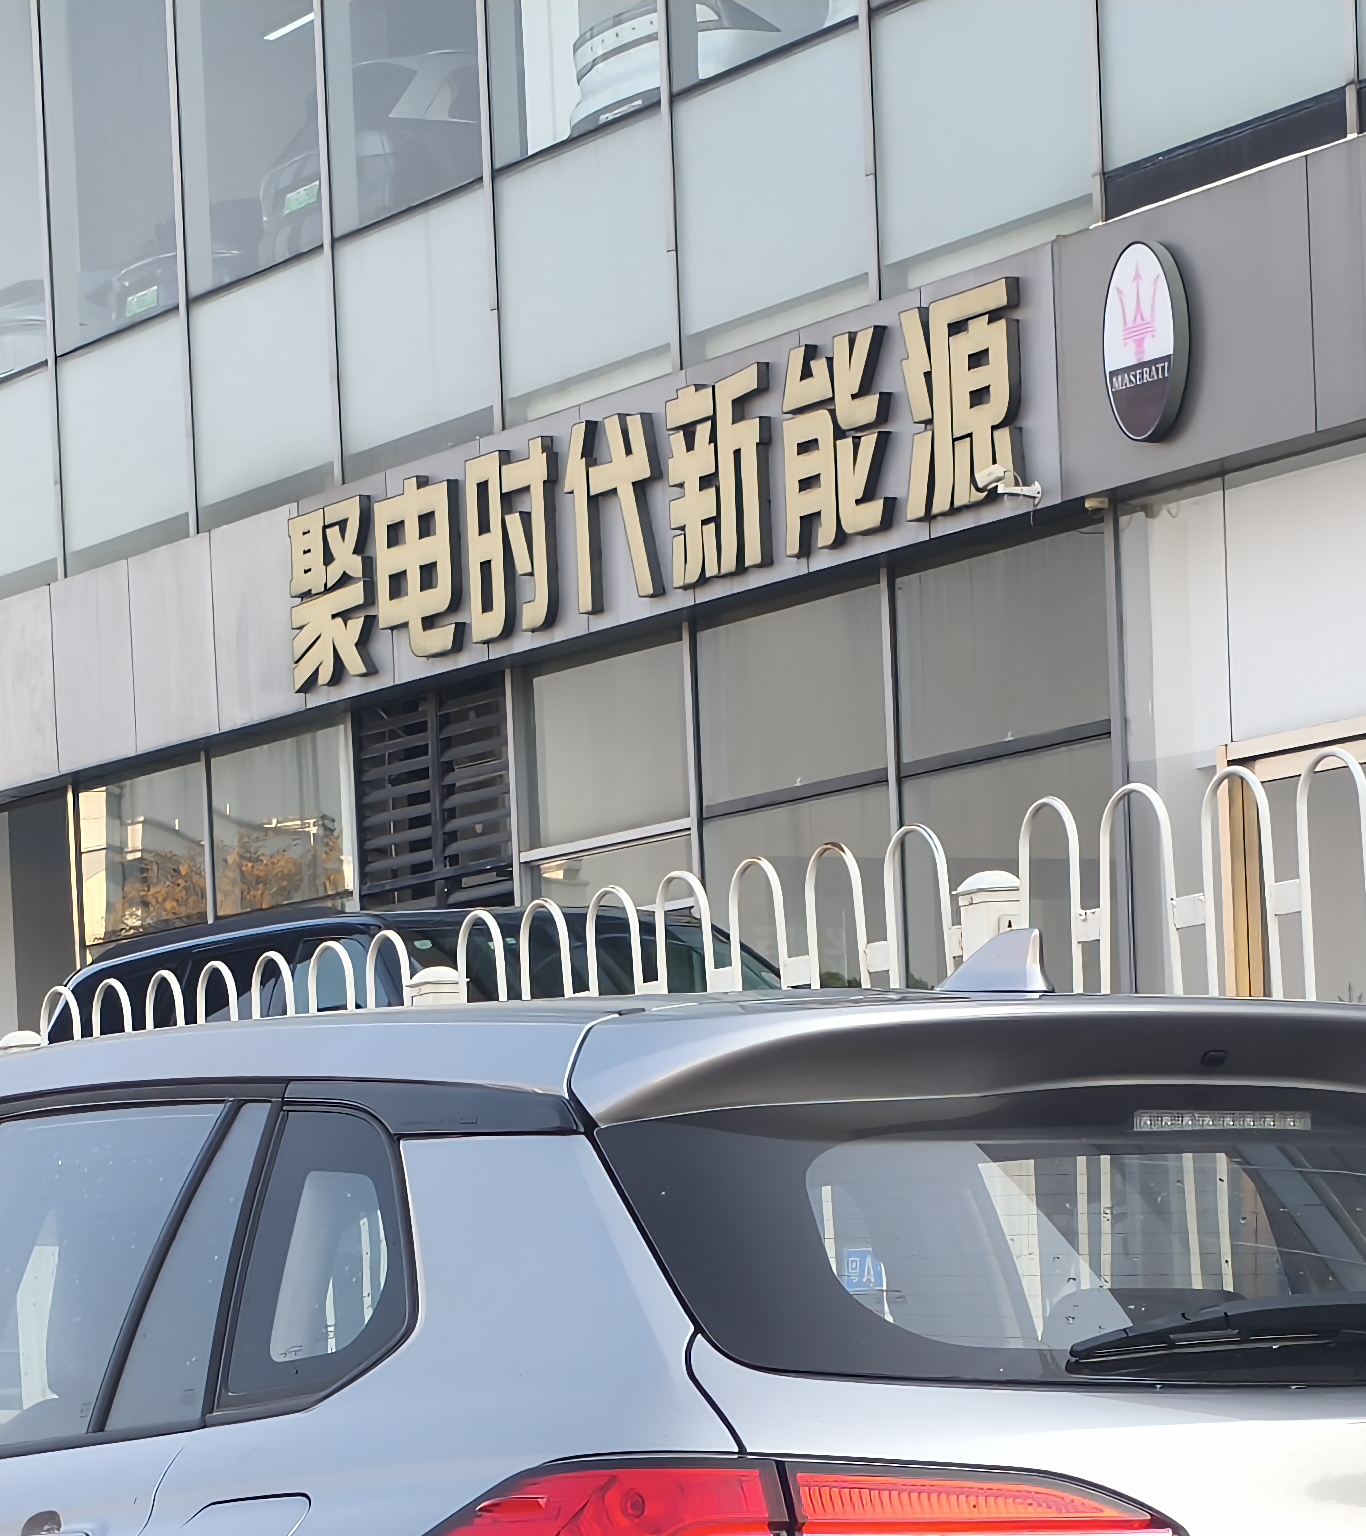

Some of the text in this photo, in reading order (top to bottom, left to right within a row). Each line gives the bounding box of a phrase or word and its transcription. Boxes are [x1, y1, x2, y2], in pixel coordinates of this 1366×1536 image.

[288, 276, 1021, 693] 聚电时代新能源
[1112, 361, 1169, 392] MASERATI
